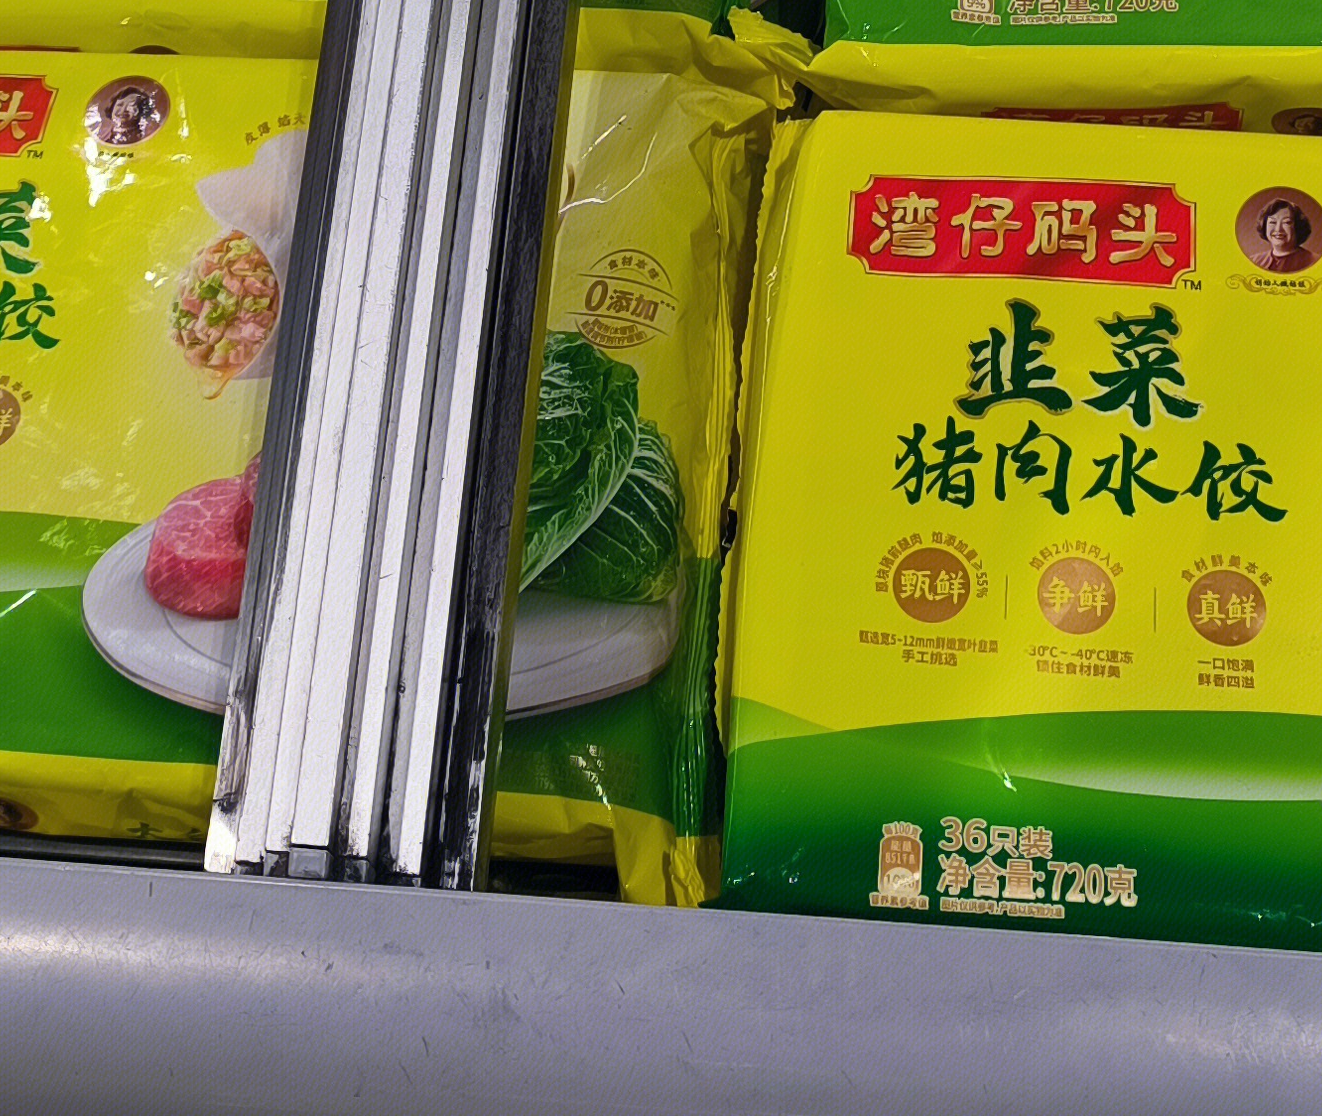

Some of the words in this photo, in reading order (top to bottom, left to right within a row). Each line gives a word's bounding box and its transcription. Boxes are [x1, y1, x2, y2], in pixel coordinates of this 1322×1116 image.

[25, 149, 45, 161] TM
[869, 192, 1179, 268] 湾仔码头
[1181, 279, 1203, 292] TM
[584, 279, 660, 323] 0添加
[954, 298, 1202, 429] 韭菜
[890, 415, 1289, 523] 猪肉水饺
[898, 568, 967, 605] 甄鲜
[1042, 576, 1109, 617] 争鲜
[1194, 590, 1259, 628] 真鲜
[938, 816, 1054, 860] 36只装
[935, 853, 1139, 908] 净含量:720克
